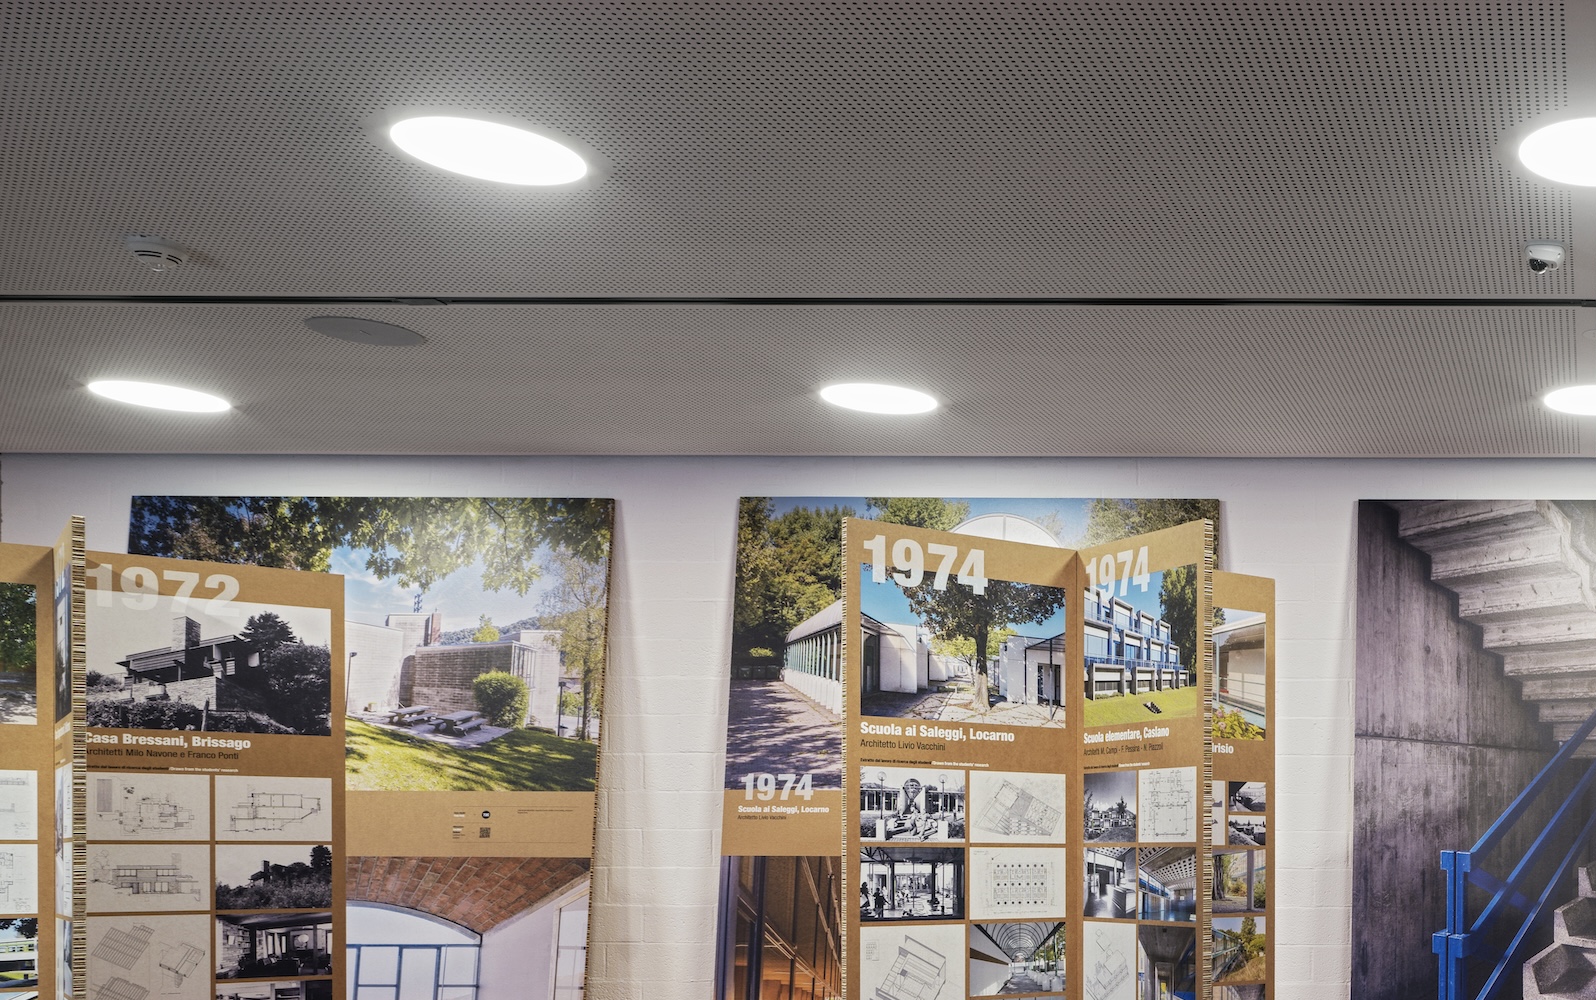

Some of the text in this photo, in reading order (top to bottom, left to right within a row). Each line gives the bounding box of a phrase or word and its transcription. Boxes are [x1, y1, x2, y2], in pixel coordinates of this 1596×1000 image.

[864, 534, 988, 595] 1974
[1086, 545, 1150, 600] 1974
[86, 563, 240, 617] 1972
[86, 732, 118, 744] Casa
[122, 733, 188, 748] Bressani,
[192, 736, 251, 750] Brissago
[860, 721, 1015, 742] Scuola ai Saleggi, Locarno
[1083, 726, 1170, 744] Scuola elementare, Caslano
[126, 749, 144, 757] Milo
[146, 749, 178, 758] Navone
[188, 751, 216, 759] Franco
[218, 752, 239, 760] Ponti
[860, 739, 946, 751] Architetto Livio Vacchini
[741, 773, 814, 801] 1974
[738, 805, 830, 814] Scuola ai Saleggi, Locarno
